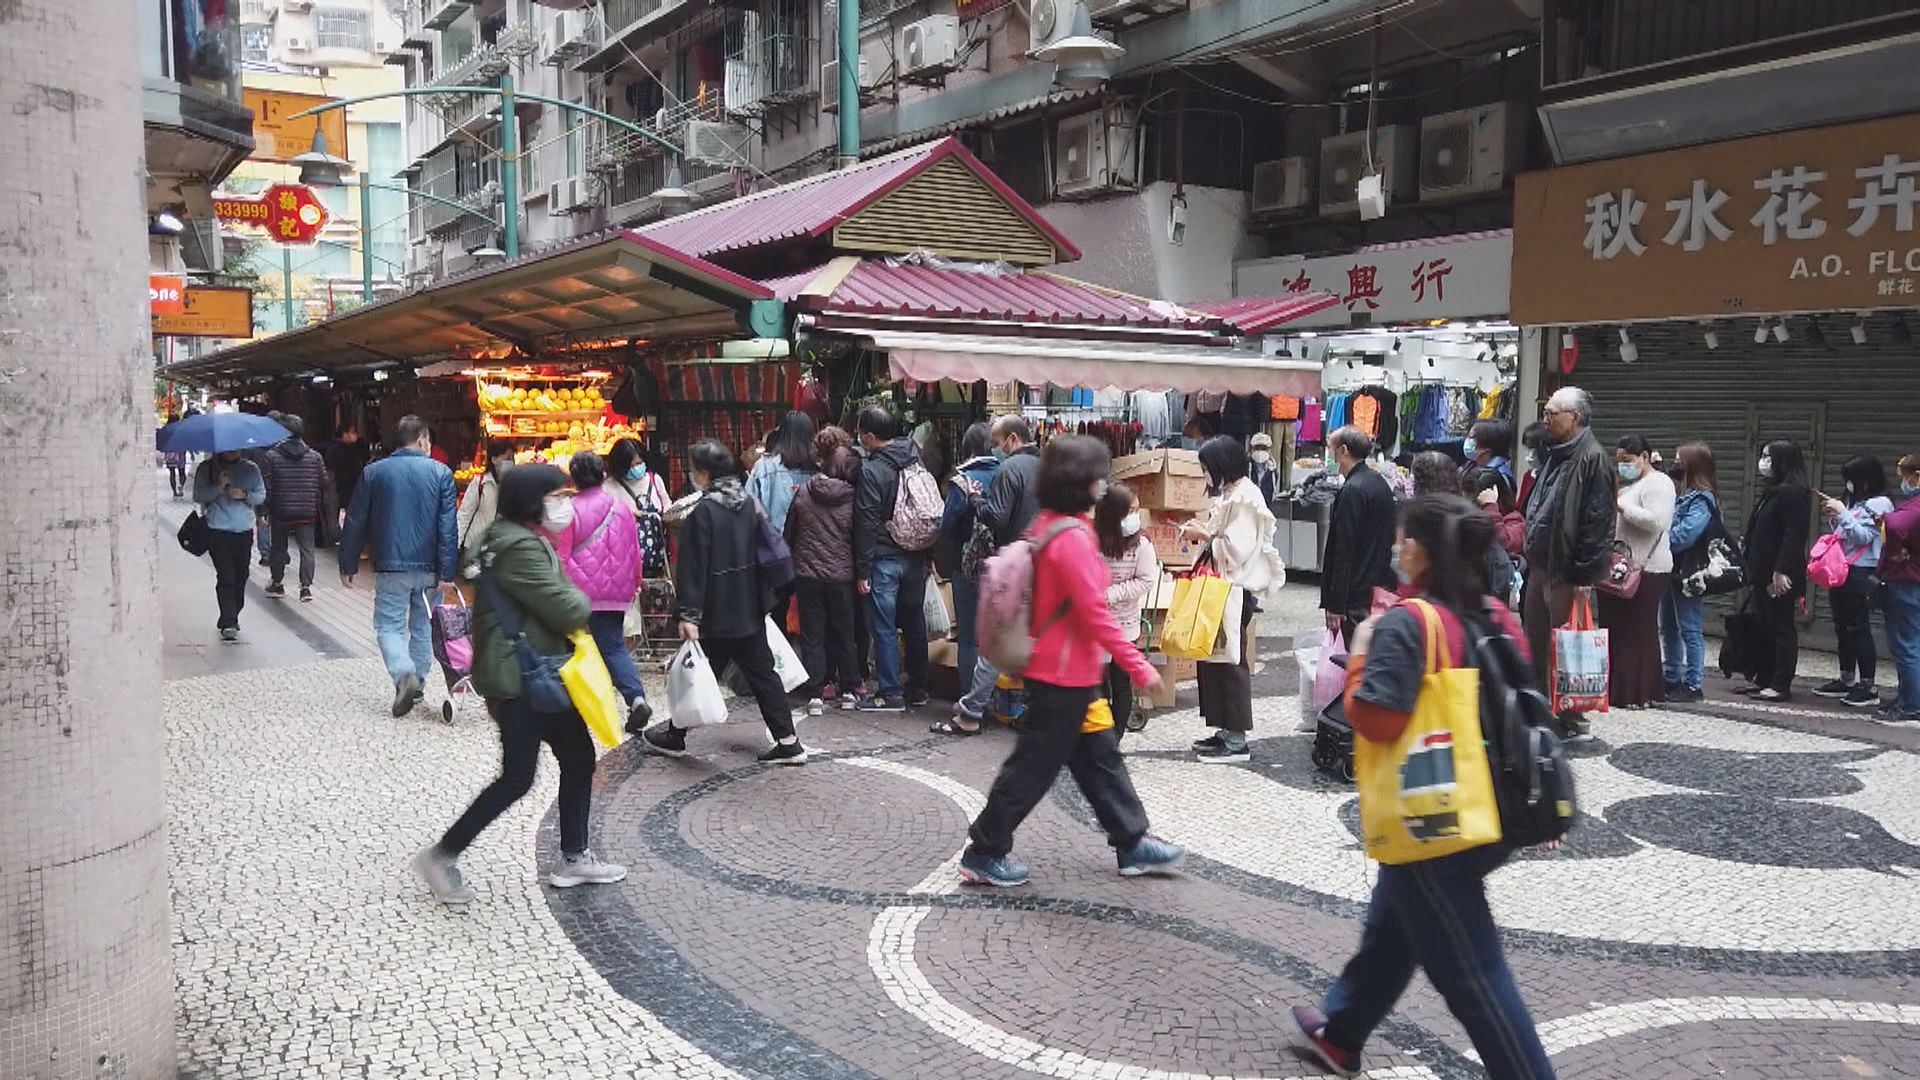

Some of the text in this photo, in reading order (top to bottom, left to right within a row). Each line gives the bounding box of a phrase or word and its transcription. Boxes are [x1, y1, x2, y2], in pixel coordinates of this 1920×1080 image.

[1583, 154, 1920, 261] 秋水花卉
[1789, 254, 1851, 280] A.O.
